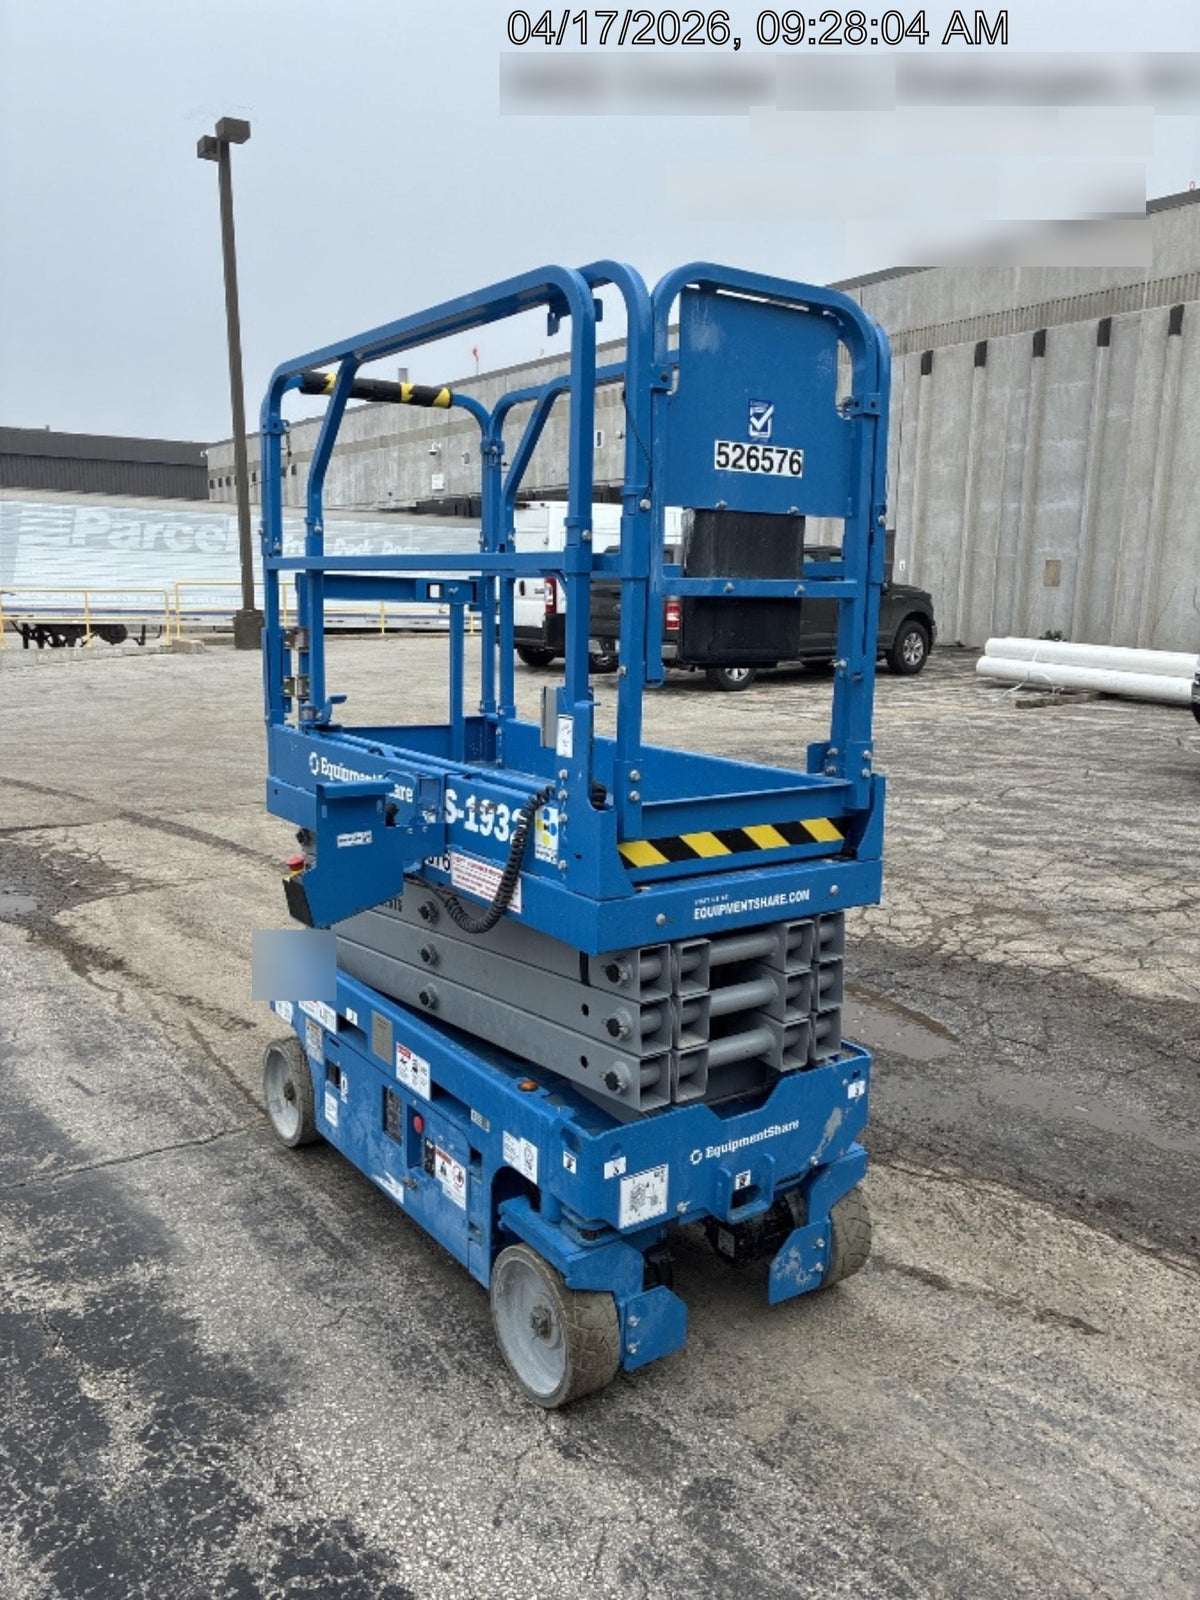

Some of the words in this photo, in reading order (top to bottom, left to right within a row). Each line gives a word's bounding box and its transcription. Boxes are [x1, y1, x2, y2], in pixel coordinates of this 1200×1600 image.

[716, 443, 802, 475] 526576
[694, 889, 810, 919] EQUIPMENTSHARE.COM
[705, 1119, 800, 1160] EquipmentShare
